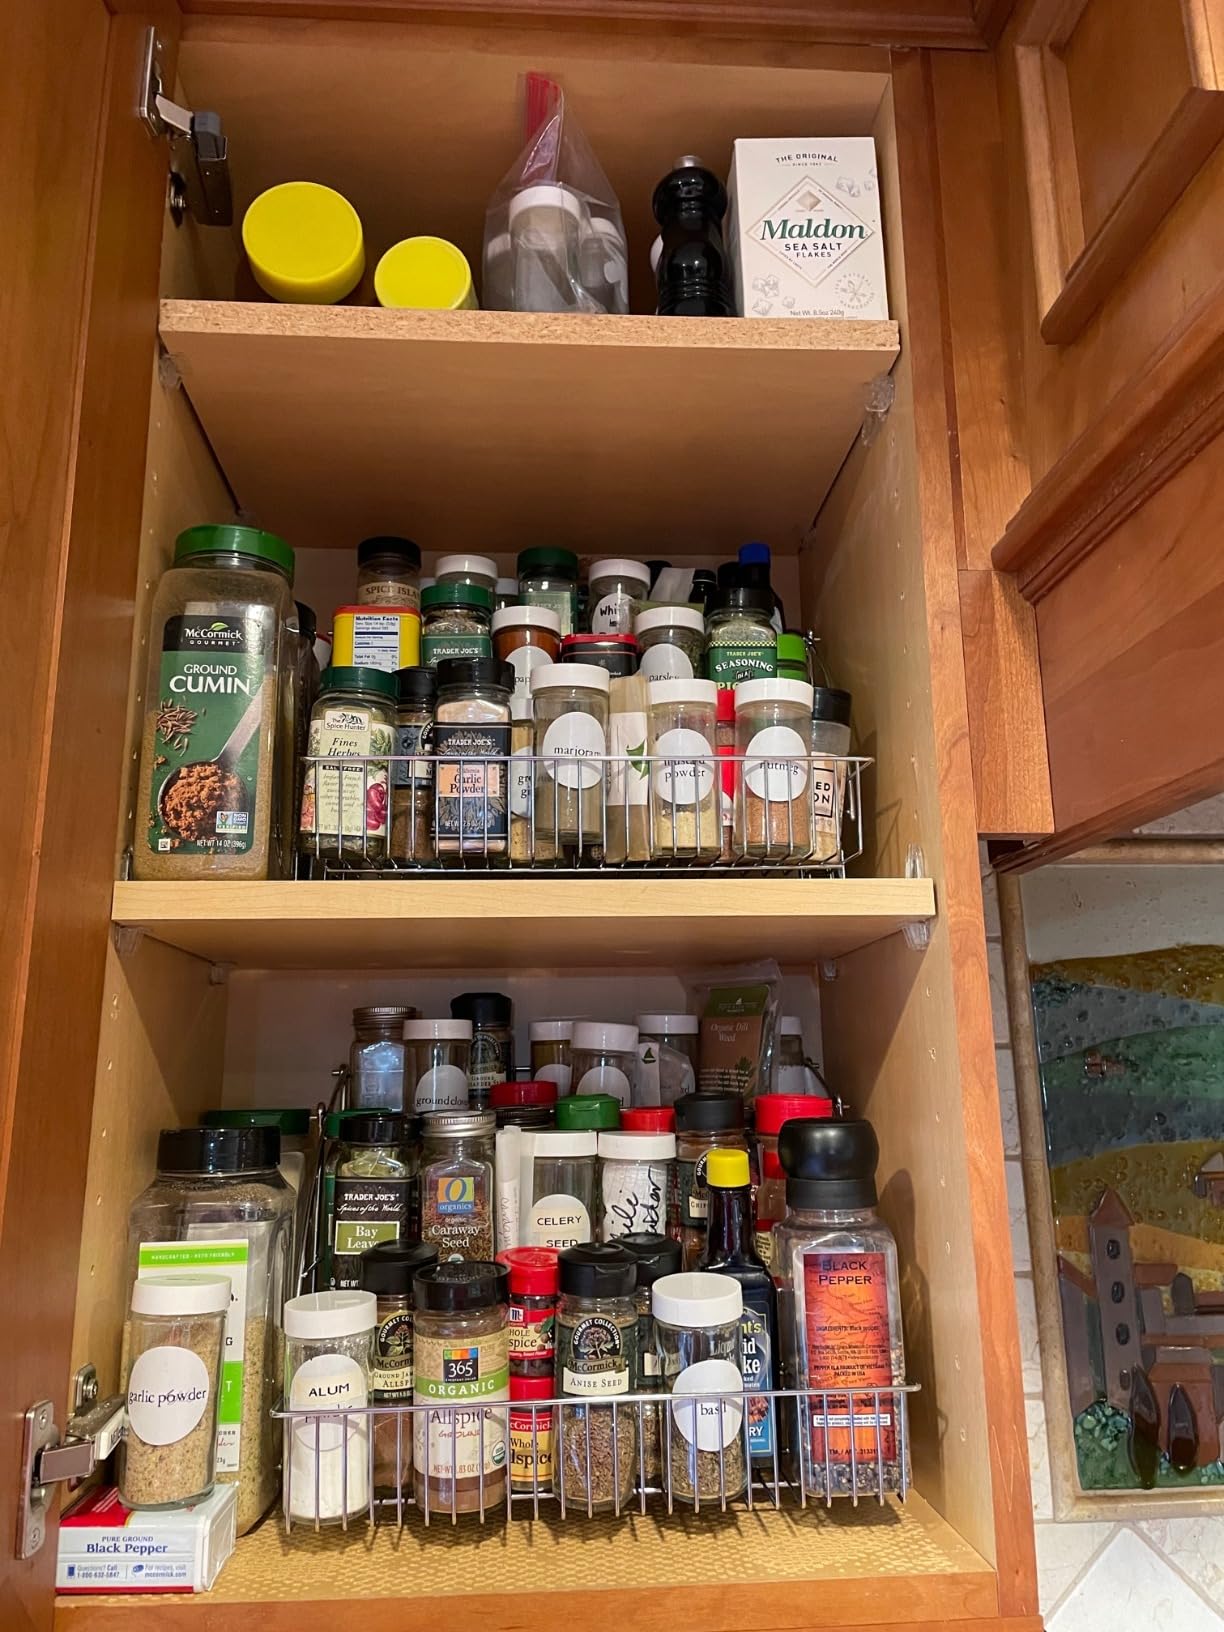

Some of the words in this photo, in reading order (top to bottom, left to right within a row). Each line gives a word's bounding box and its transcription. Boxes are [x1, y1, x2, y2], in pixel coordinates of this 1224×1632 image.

[796, 153, 838, 162] ORIGINAL
[760, 218, 866, 240] Maldon
[785, 243, 808, 251] SEA
[813, 242, 842, 250] SALT
[398, 586, 417, 598] ISLA
[184, 628, 243, 640] McCormick
[184, 664, 237, 675] GROUND
[715, 658, 774, 672] SEASONING
[169, 675, 252, 695] CUMIN
[332, 737, 358, 747] Fines
[816, 782, 830, 791] ED
[814, 792, 830, 804] ON
[416, 1096, 450, 1107] ground
[337, 1203, 360, 1214] Spices
[382, 1203, 403, 1212] World
[440, 1203, 472, 1212] organics
[537, 1215, 582, 1226] CELERY
[356, 1226, 378, 1238] Bay
[432, 1224, 480, 1236] Caraway
[442, 1237, 469, 1248] Seed
[546, 1239, 578, 1248] SEED
[822, 1260, 867, 1271] BLACK
[819, 1275, 872, 1285] PEPPER
[381, 1317, 400, 1342] GOURMET
[574, 1319, 593, 1344] GOURMET
[594, 1319, 620, 1345] COLLECTION
[742, 1320, 762, 1334] nt's
[225, 1337, 233, 1346] G
[509, 1338, 537, 1350] spice
[742, 1338, 756, 1354] id
[376, 1357, 413, 1368] McCorm
[448, 1360, 473, 1377] 365
[570, 1360, 619, 1371] McCormick
[743, 1356, 760, 1374] ke
[226, 1381, 232, 1392] T
[309, 1383, 349, 1397] ALUM
[428, 1380, 495, 1396] ORGANIC
[129, 1390, 155, 1404] garlic
[158, 1388, 207, 1407] powder
[700, 1400, 726, 1415] basl
[430, 1408, 492, 1429] Allspice
[510, 1421, 552, 1430] cCormick
[749, 1426, 763, 1436] RY
[511, 1449, 552, 1468] lspice
[86, 1543, 123, 1553] Black
[125, 1544, 168, 1555] Pepper
